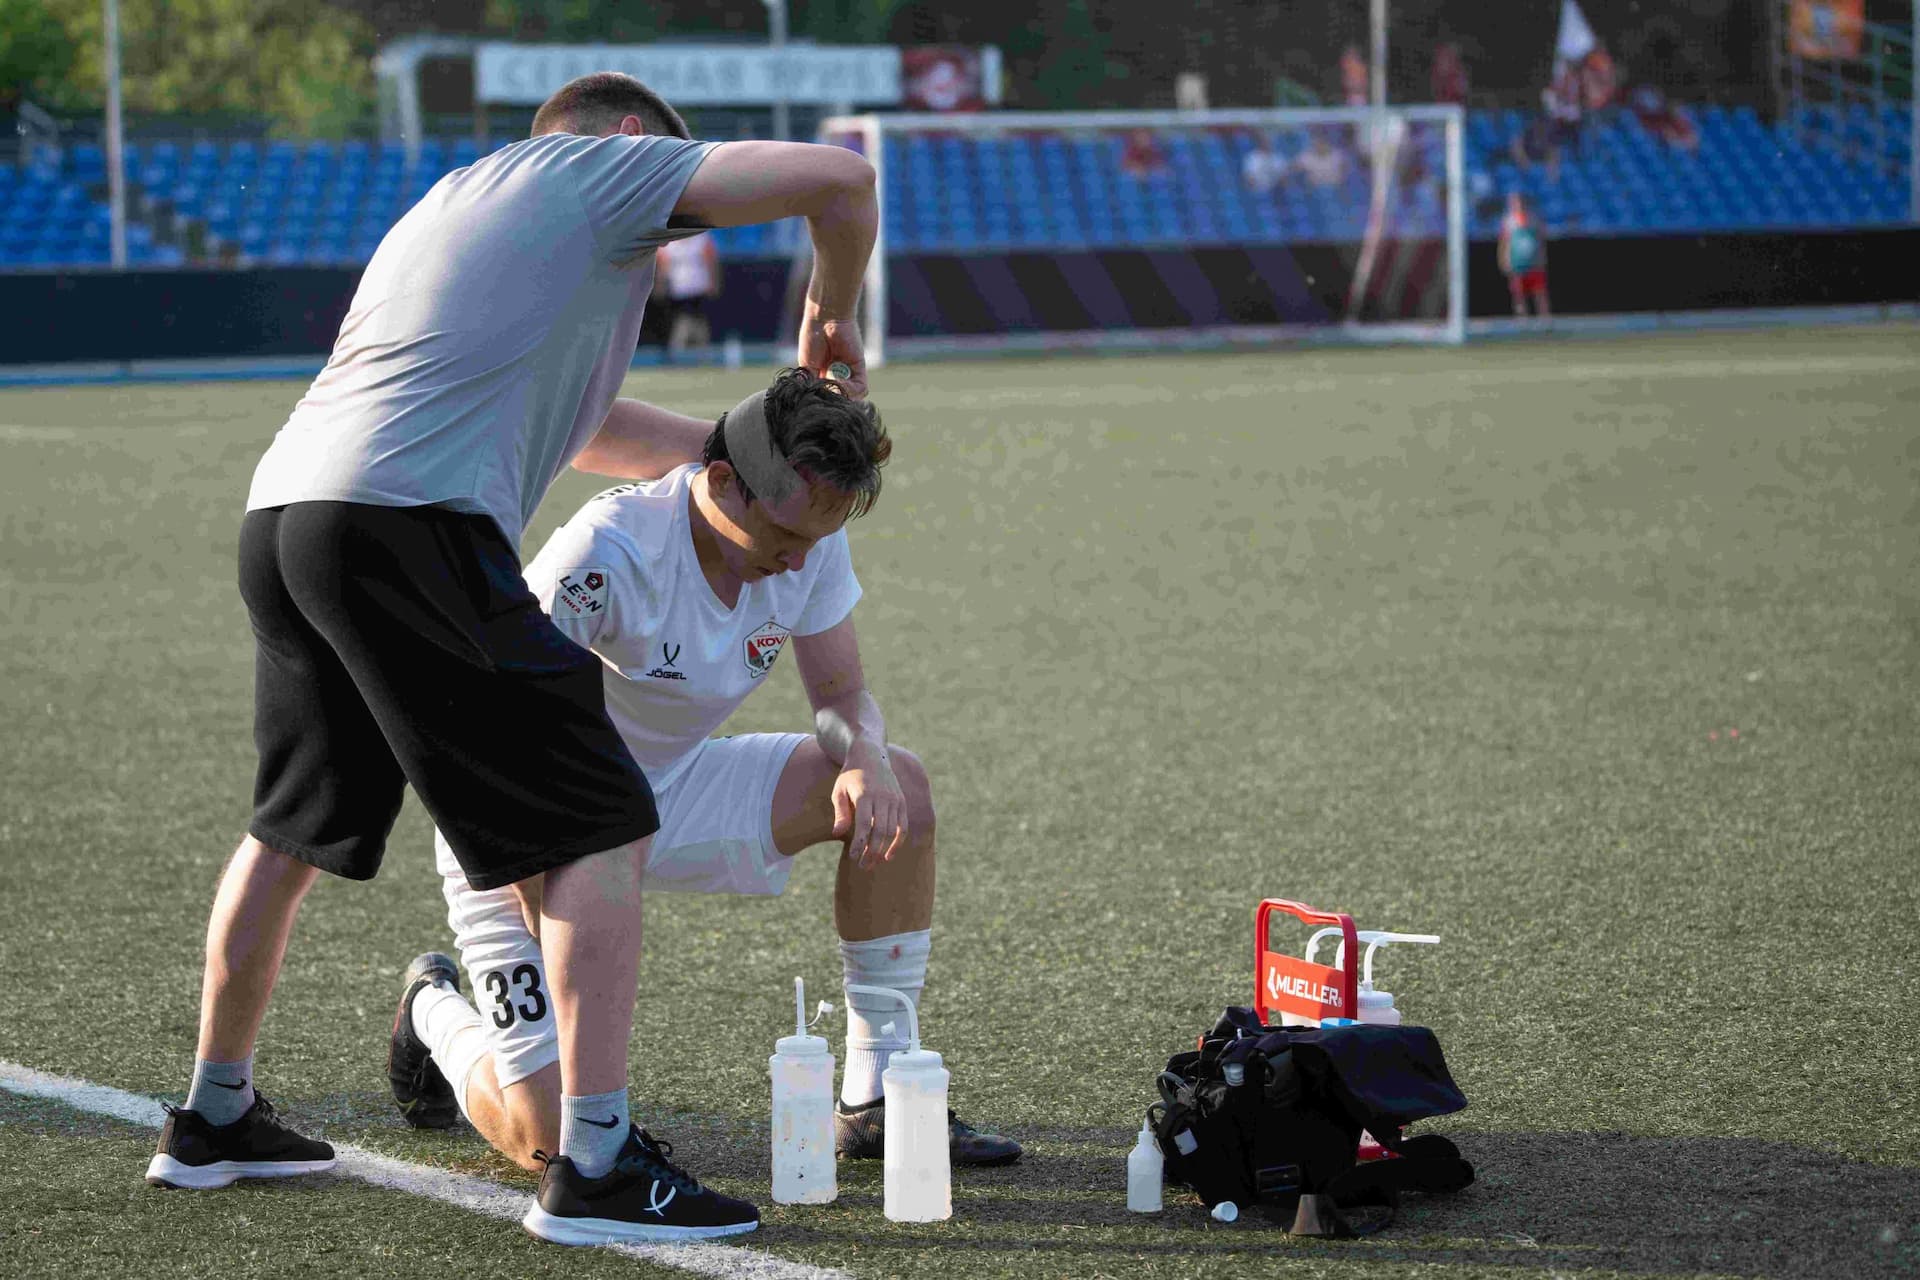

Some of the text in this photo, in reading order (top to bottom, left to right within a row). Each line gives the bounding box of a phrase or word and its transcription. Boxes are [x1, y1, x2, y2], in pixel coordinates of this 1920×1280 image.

[559, 575, 603, 612] LEON
[485, 963, 547, 1030] 33
[1276, 973, 1339, 1007] MUELLER
